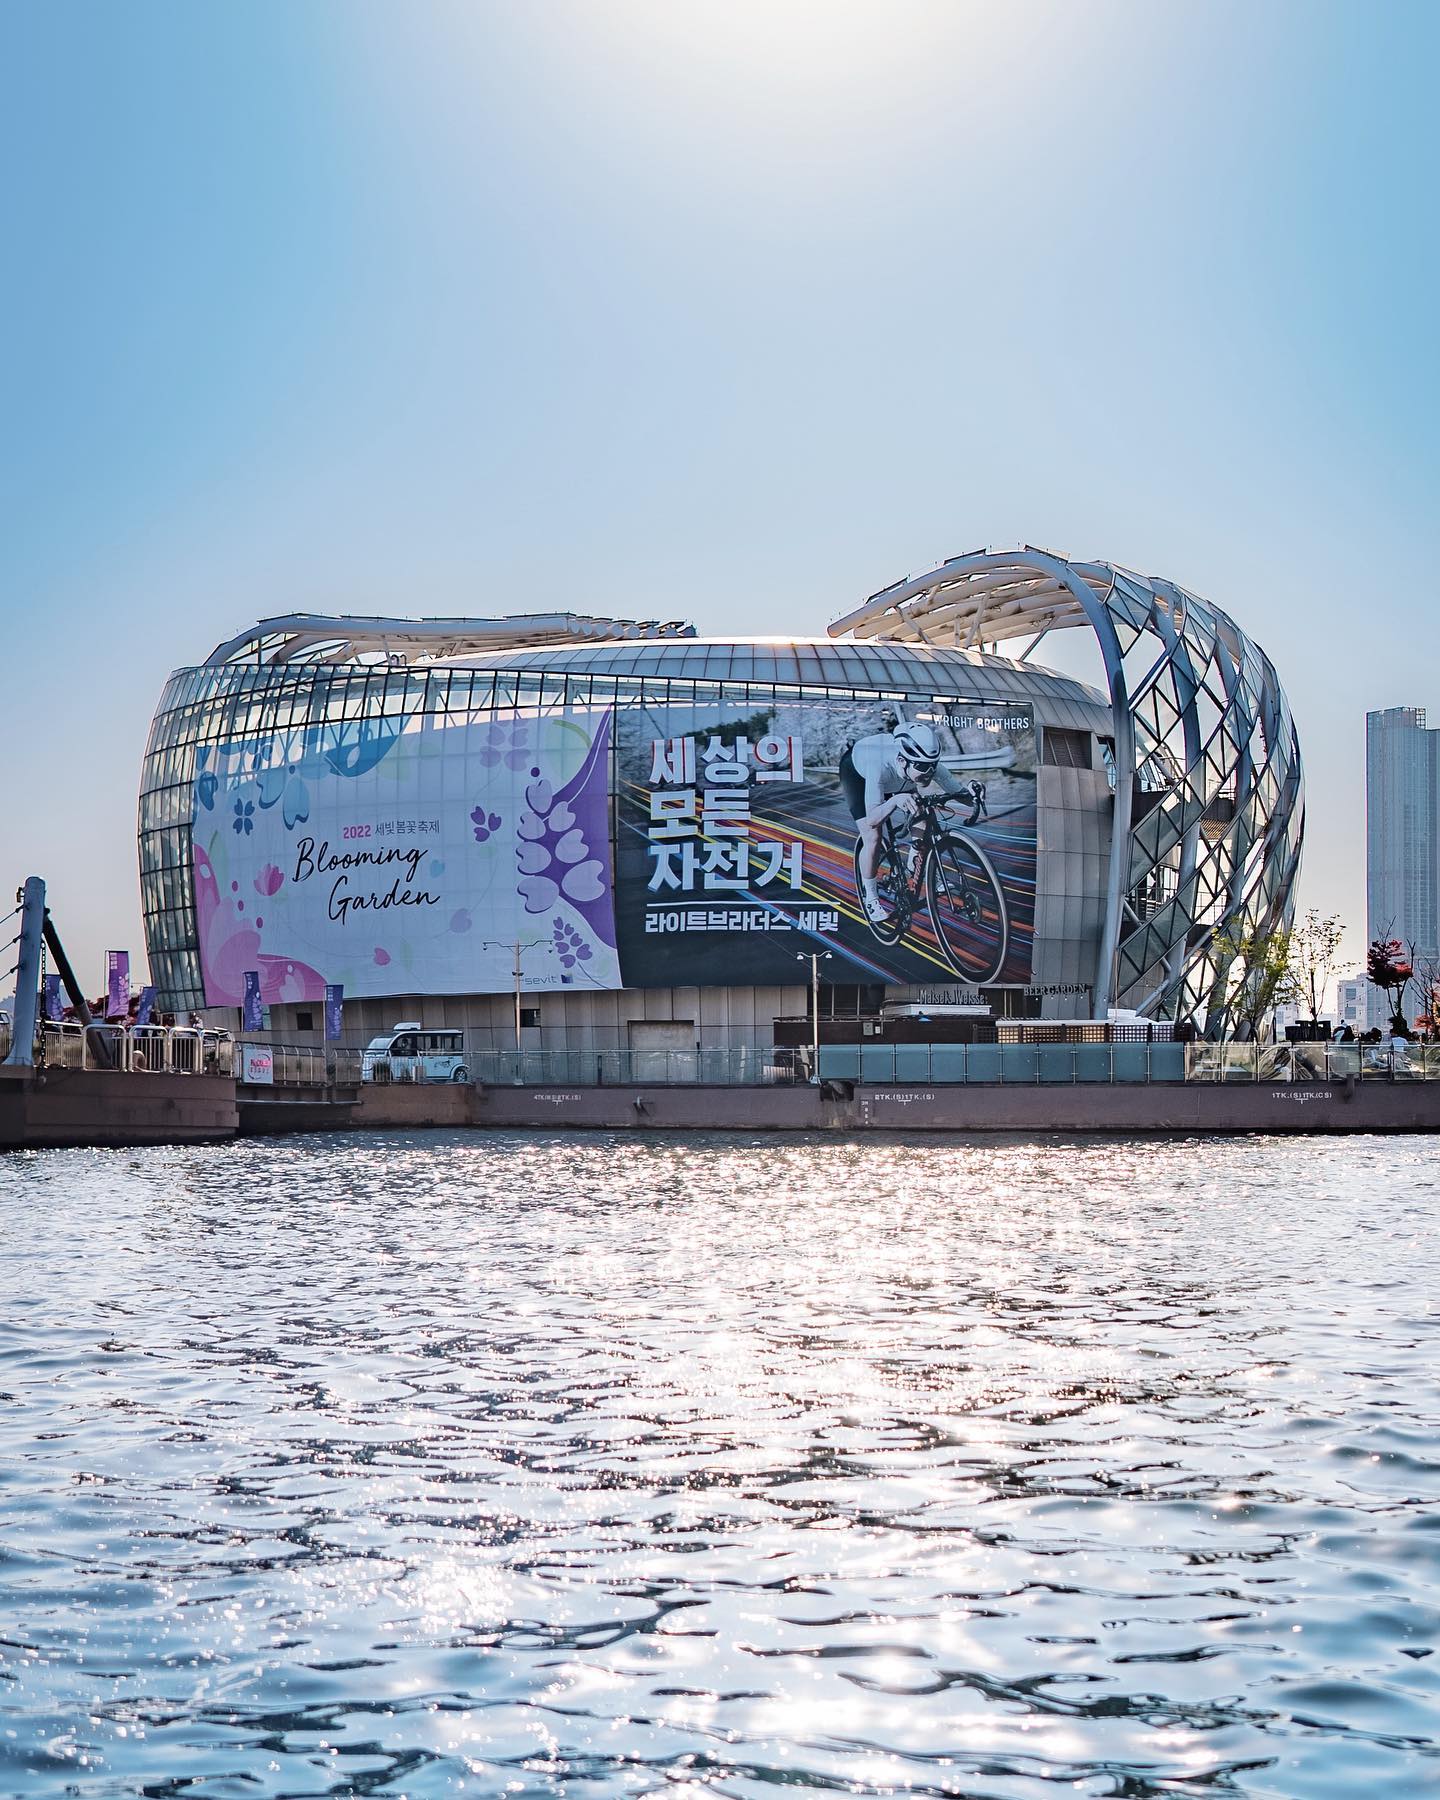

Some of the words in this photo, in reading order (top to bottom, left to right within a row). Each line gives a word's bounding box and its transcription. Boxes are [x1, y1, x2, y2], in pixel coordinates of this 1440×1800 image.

[932, 714, 974, 729] WRIGHT
[976, 717, 1029, 730] BROTHERS
[649, 735, 804, 784] 세상의
[343, 825, 372, 839] 2022
[647, 788, 751, 838] 모든
[292, 837, 429, 883] Blooming
[647, 841, 804, 892] 자전거
[328, 875, 441, 926] Garden
[645, 911, 792, 933] 라이트브라더스
[797, 911, 839, 933] 세빛
